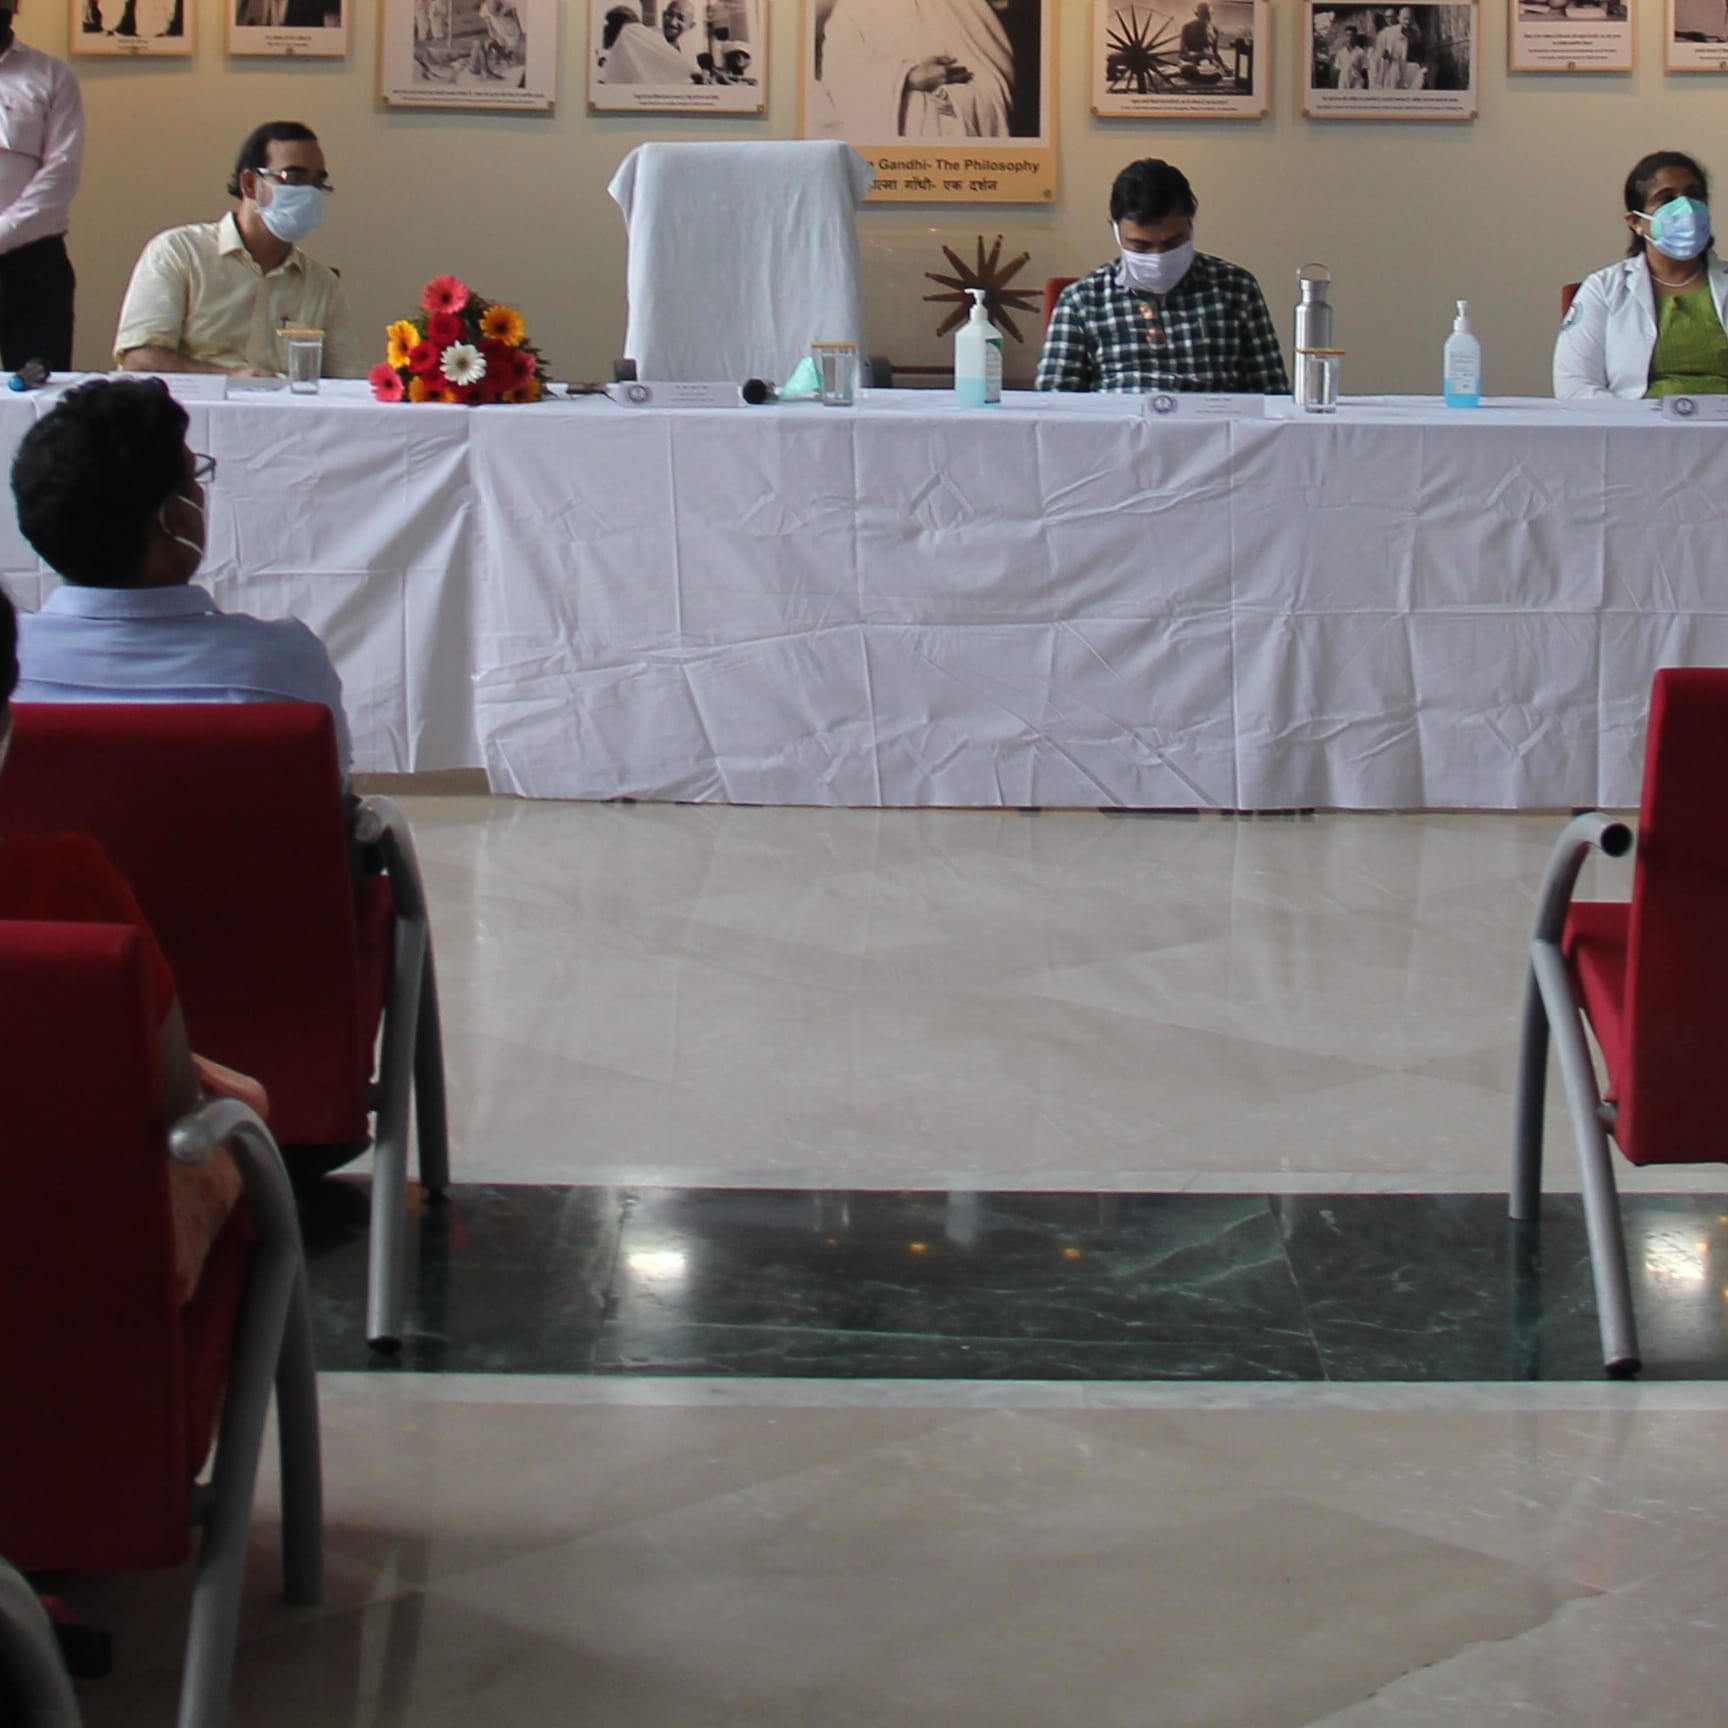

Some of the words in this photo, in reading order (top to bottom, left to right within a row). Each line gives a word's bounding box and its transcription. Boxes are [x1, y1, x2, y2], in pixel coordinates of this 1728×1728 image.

[936, 159, 961, 171] The
[964, 159, 1040, 173] Philosophy
[943, 179, 963, 191] एक
